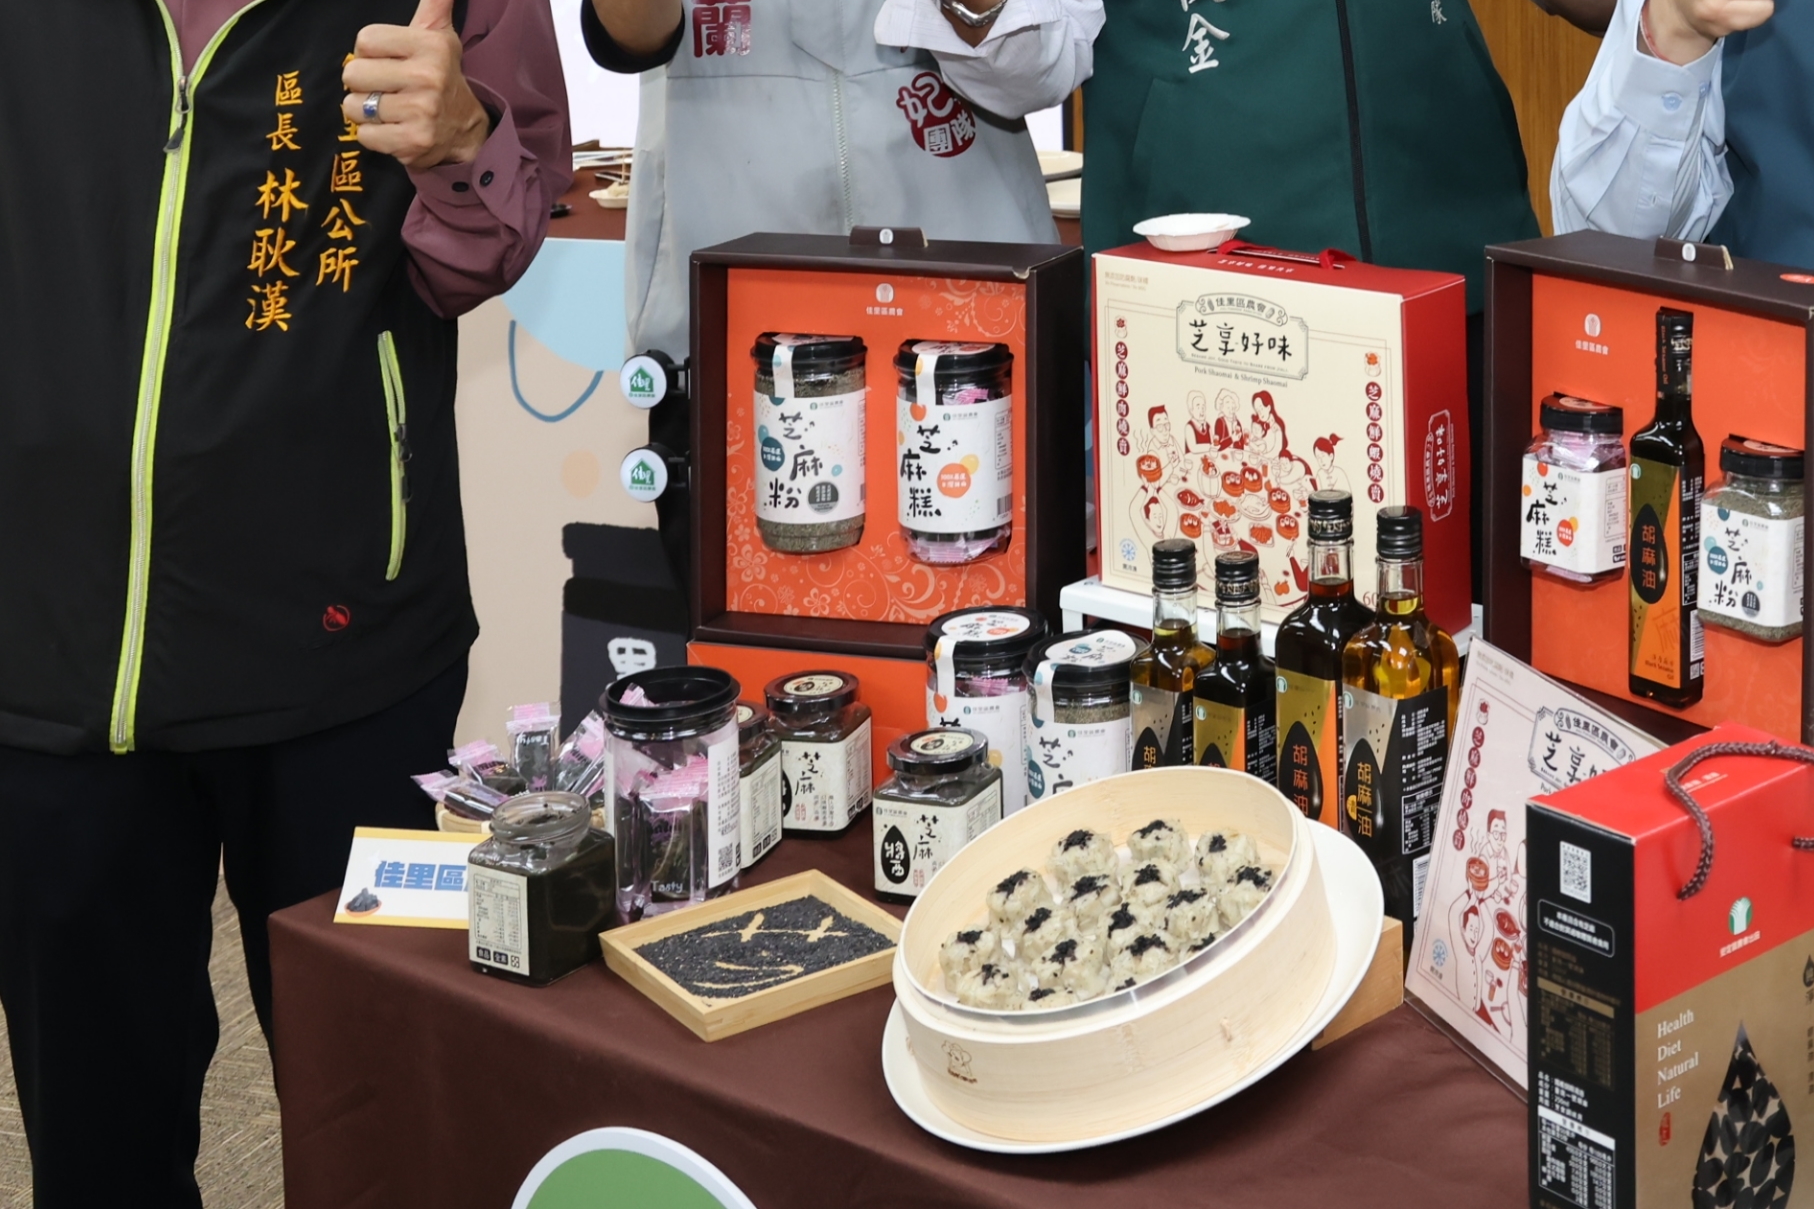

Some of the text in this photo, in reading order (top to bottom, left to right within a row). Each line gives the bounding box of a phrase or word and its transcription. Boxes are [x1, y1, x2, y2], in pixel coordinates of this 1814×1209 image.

[315, 52, 366, 293] 區公所
[244, 70, 310, 332] 區長 林耿漢
[1215, 296, 1267, 314] 佳里區農會
[1189, 319, 1292, 362] 芝享好味
[1194, 366, 1207, 376] Pork
[769, 411, 823, 509] 芝麻粉
[900, 424, 942, 519] 芝麻糕
[1526, 481, 1558, 555] 芝麻糕
[1642, 524, 1656, 590] 胡麻油
[1714, 527, 1752, 608] 芝麻粉
[1572, 717, 1620, 752] 佳里區農會
[795, 751, 823, 796] 芝麻
[1293, 744, 1309, 817] 胡麻油
[1356, 761, 1374, 838] 胡麻油
[913, 813, 940, 861] 芝麻
[374, 858, 468, 893] 佳里區
[651, 879, 684, 893] Tasty
[1657, 1008, 1695, 1040] Health
[1657, 1039, 1682, 1062] Diet
[1657, 1051, 1700, 1086] Natural
[1657, 1088, 1682, 1110] Life
